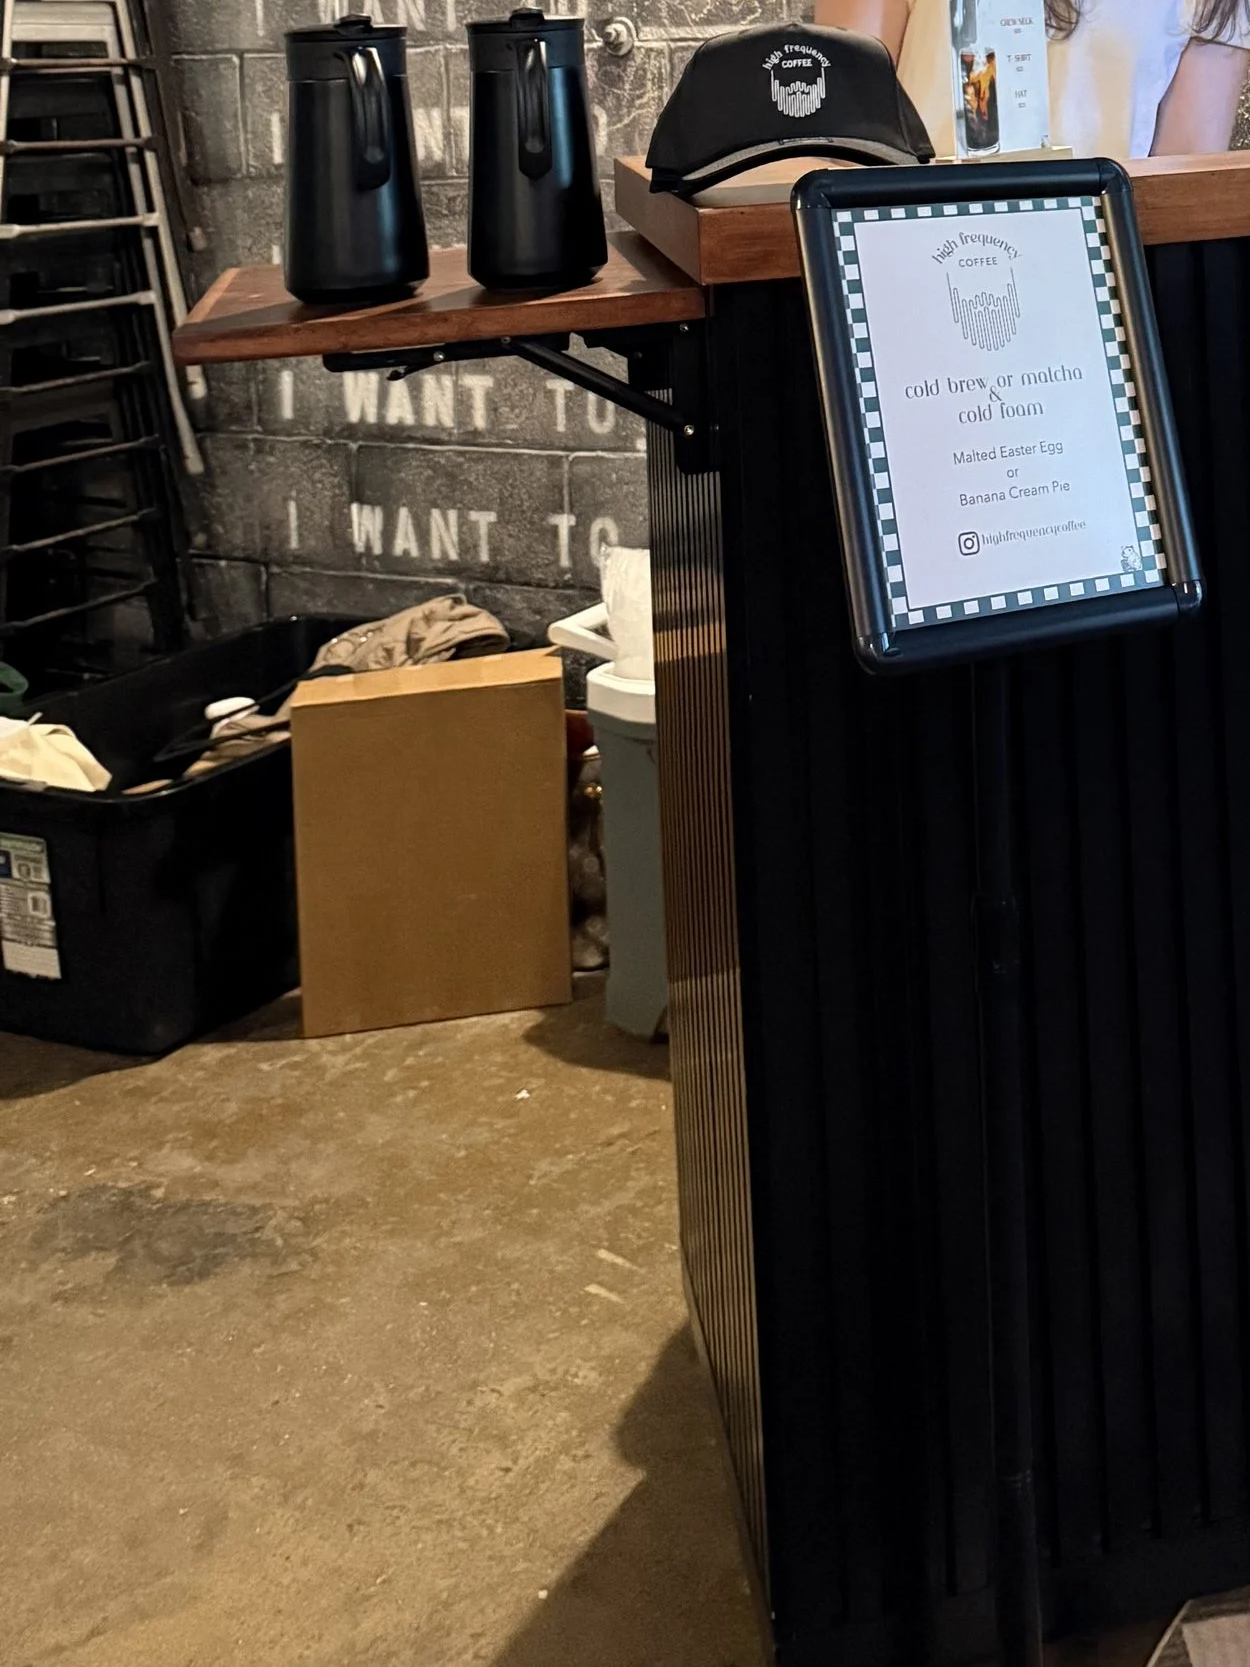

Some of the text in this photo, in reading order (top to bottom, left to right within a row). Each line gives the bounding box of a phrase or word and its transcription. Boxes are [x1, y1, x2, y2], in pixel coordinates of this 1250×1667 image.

[762, 44, 831, 71] high frequency
[781, 59, 813, 69] COFFEE
[931, 231, 1022, 264] high frequency
[958, 256, 998, 268] COFFEE
[905, 365, 1083, 400] cold brew or matcha
[989, 384, 1003, 403] &
[279, 369, 616, 434] I WANT TO
[958, 401, 1044, 424] cold foam
[952, 440, 1064, 465] Malted Easter Egg
[1006, 468, 1019, 478] or
[959, 480, 1071, 507] Banana Cream Pie
[287, 498, 299, 550] I
[350, 501, 497, 563] WANT
[981, 519, 1086, 546] highfrequencycoffee
